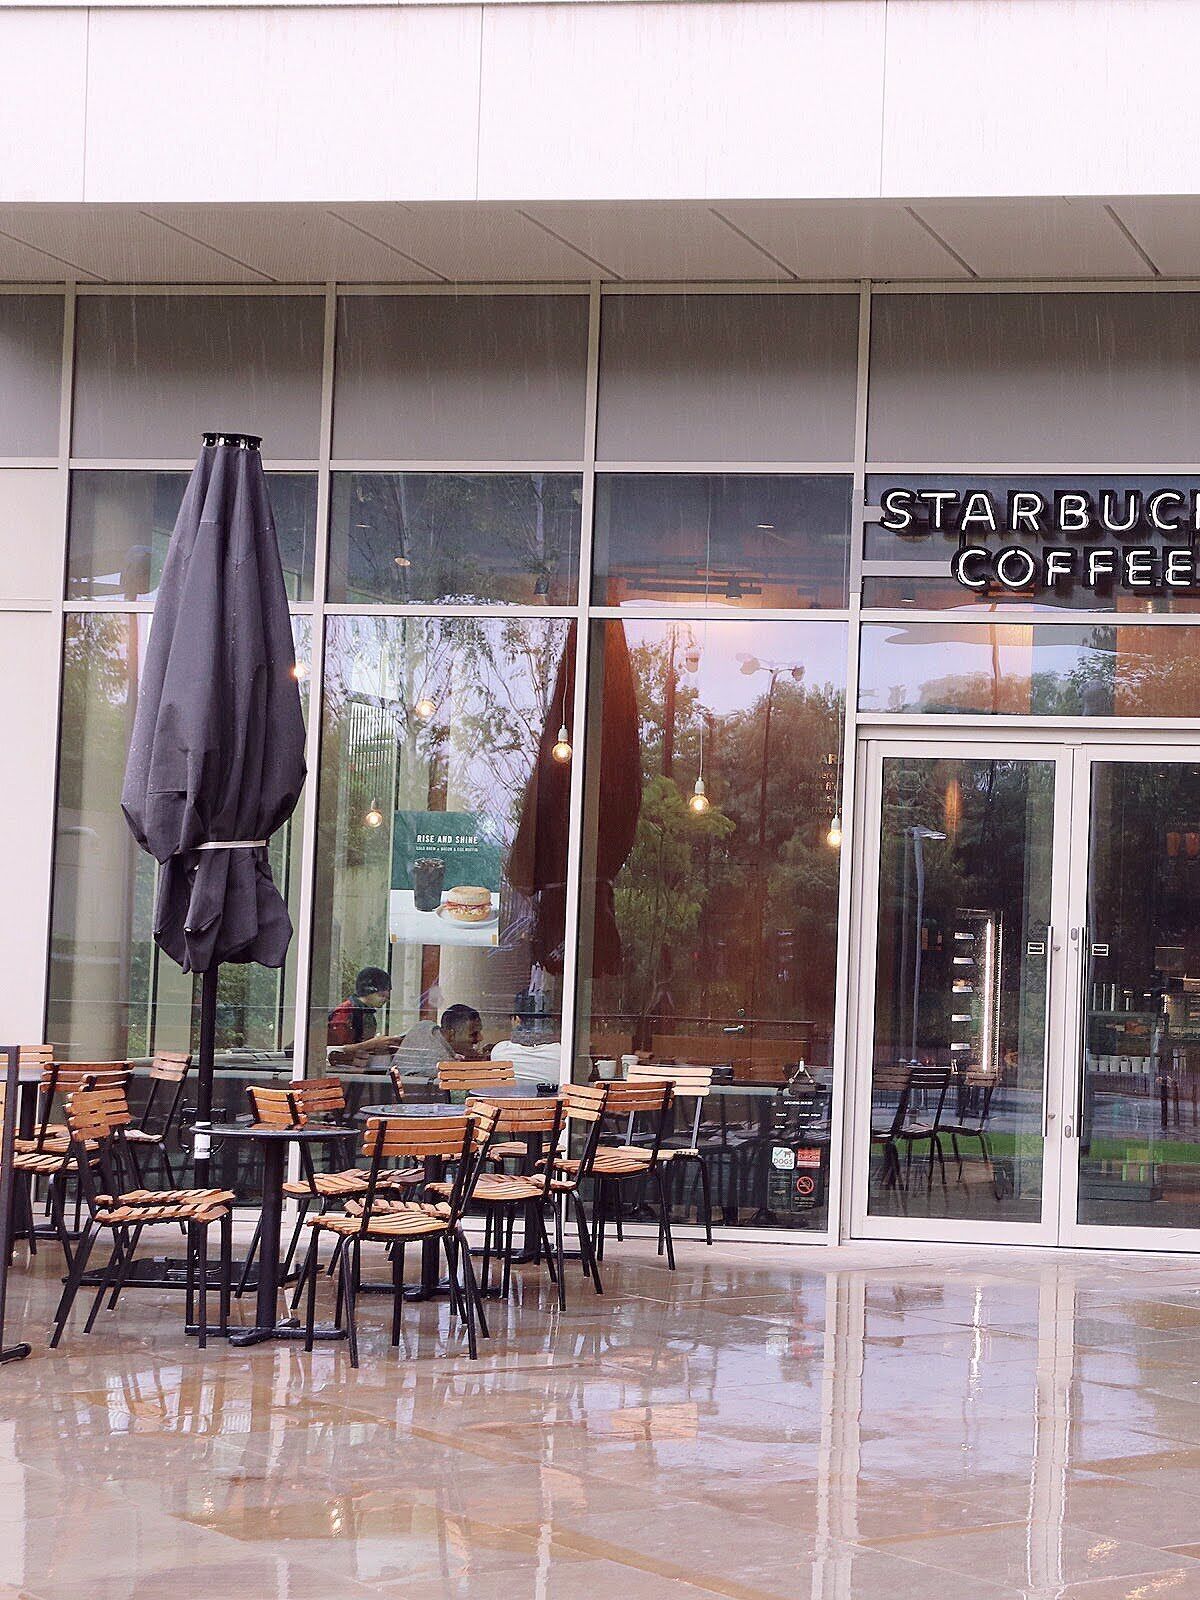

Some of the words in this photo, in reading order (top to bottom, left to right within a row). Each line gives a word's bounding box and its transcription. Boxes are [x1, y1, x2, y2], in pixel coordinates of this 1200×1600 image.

[953, 547, 1196, 588] COFFEE
[416, 834, 435, 843] RISE
[437, 835, 453, 844] AND
[455, 835, 479, 844] SHINE
